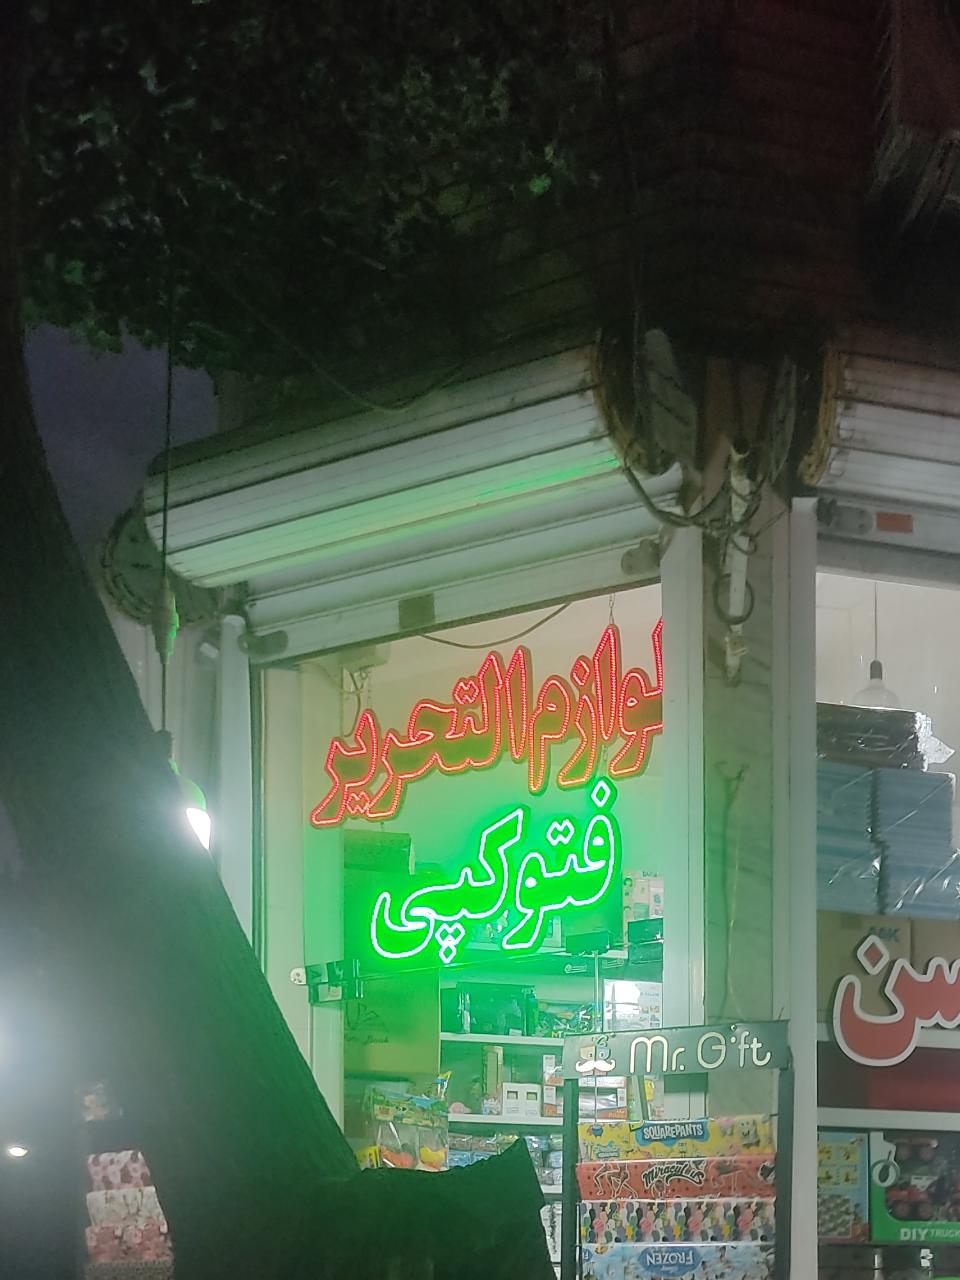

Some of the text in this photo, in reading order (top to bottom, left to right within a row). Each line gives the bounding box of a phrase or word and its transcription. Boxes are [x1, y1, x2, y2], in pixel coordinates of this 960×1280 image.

[370, 780, 616, 965] فتوکپی
[629, 1034, 686, 1073] Mr.
[642, 1124, 705, 1140] SQUAREPANTS
[900, 1228, 928, 1241] DIY
[646, 1250, 695, 1266] FROZEN
